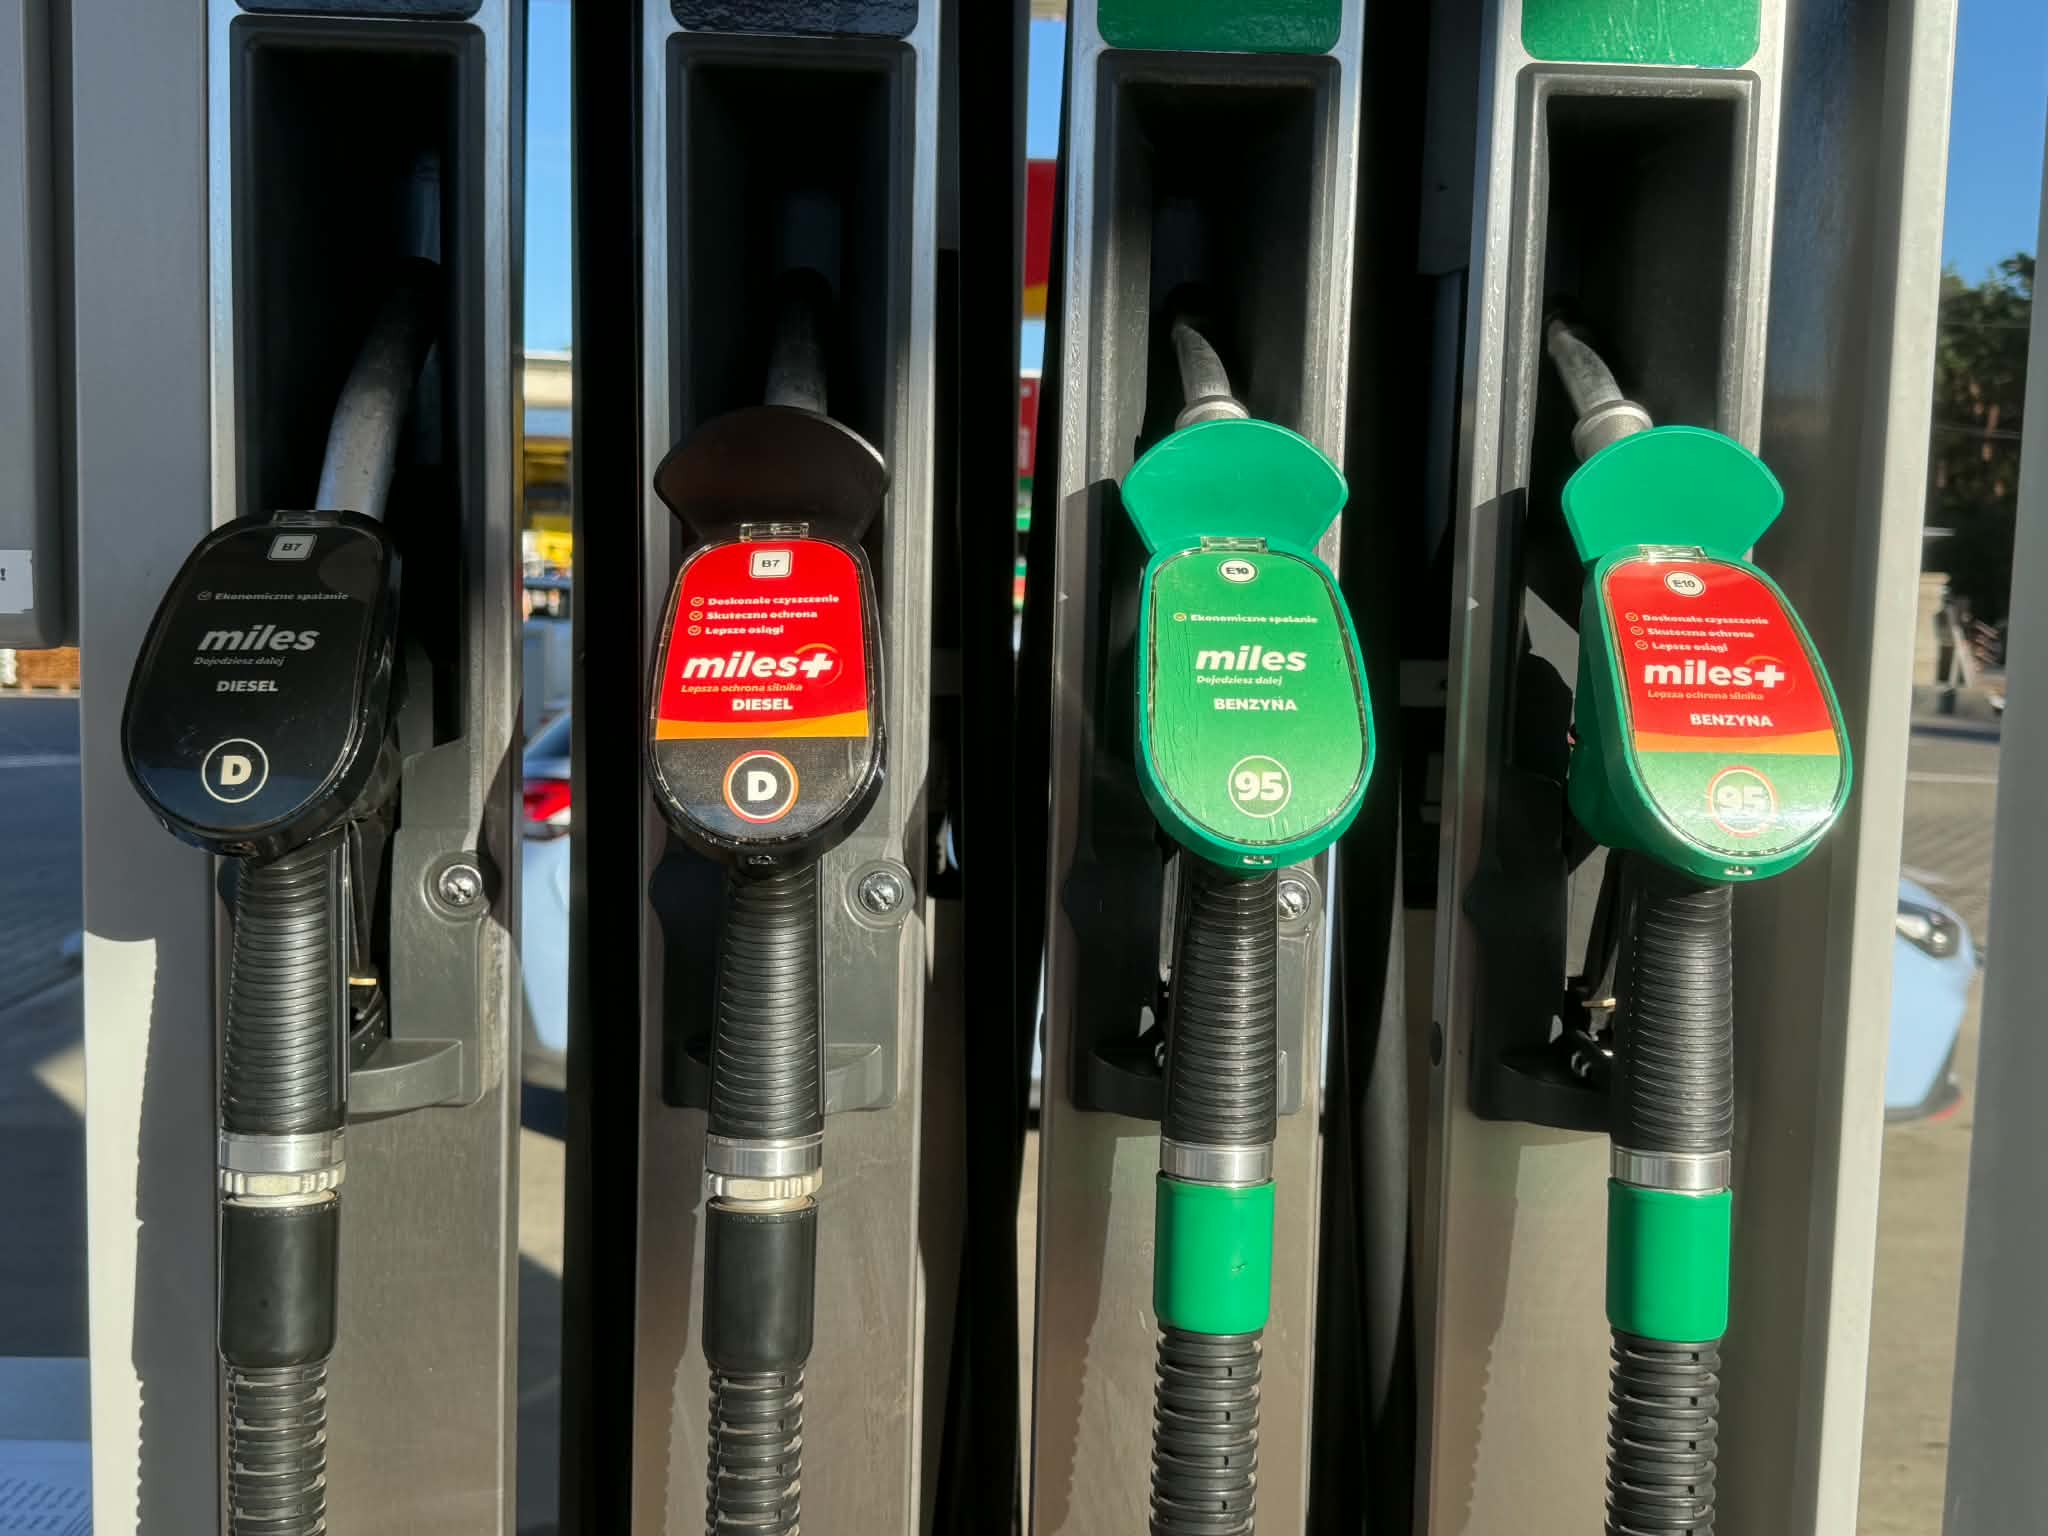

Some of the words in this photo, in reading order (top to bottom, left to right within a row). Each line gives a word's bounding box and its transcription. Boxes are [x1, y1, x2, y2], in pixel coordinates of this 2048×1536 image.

[282, 543, 303, 551] B7
[761, 559, 781, 568] B7
[1226, 567, 1250, 575] E10
[1672, 579, 1696, 588] E10
[215, 592, 295, 600] Ekonomiczne
[773, 594, 840, 605] czyszczenie
[706, 611, 768, 620] Skuteczna
[770, 609, 818, 619] ochrona
[1190, 613, 1266, 623] Ekonomiczne
[705, 626, 746, 636] Lepsze
[1647, 628, 1707, 637] Skuteczna
[1708, 629, 1755, 638] ochrona
[197, 624, 320, 651] miles
[1652, 642, 1692, 652] Lepsze
[193, 656, 254, 666] Dojedziesz
[255, 656, 286, 667] dalej
[1195, 645, 1308, 672] miles
[216, 680, 279, 692] DIESEL
[1196, 675, 1253, 686] Dojedziesz
[1255, 676, 1283, 686] dalej
[681, 685, 719, 695] Lepsza
[721, 684, 765, 693] ochrona
[767, 683, 803, 692] silnika
[1648, 689, 1684, 699] Lepsza
[1685, 690, 1728, 700] ochrona
[1729, 691, 1765, 701] silnika
[732, 698, 794, 711] DIESEL
[1213, 698, 1298, 711] BENZYNA
[1689, 713, 1774, 727] BENZYNA
[220, 755, 252, 785] D
[747, 771, 778, 801] D
[1235, 771, 1284, 801] 95
[1717, 785, 1769, 817] 95
